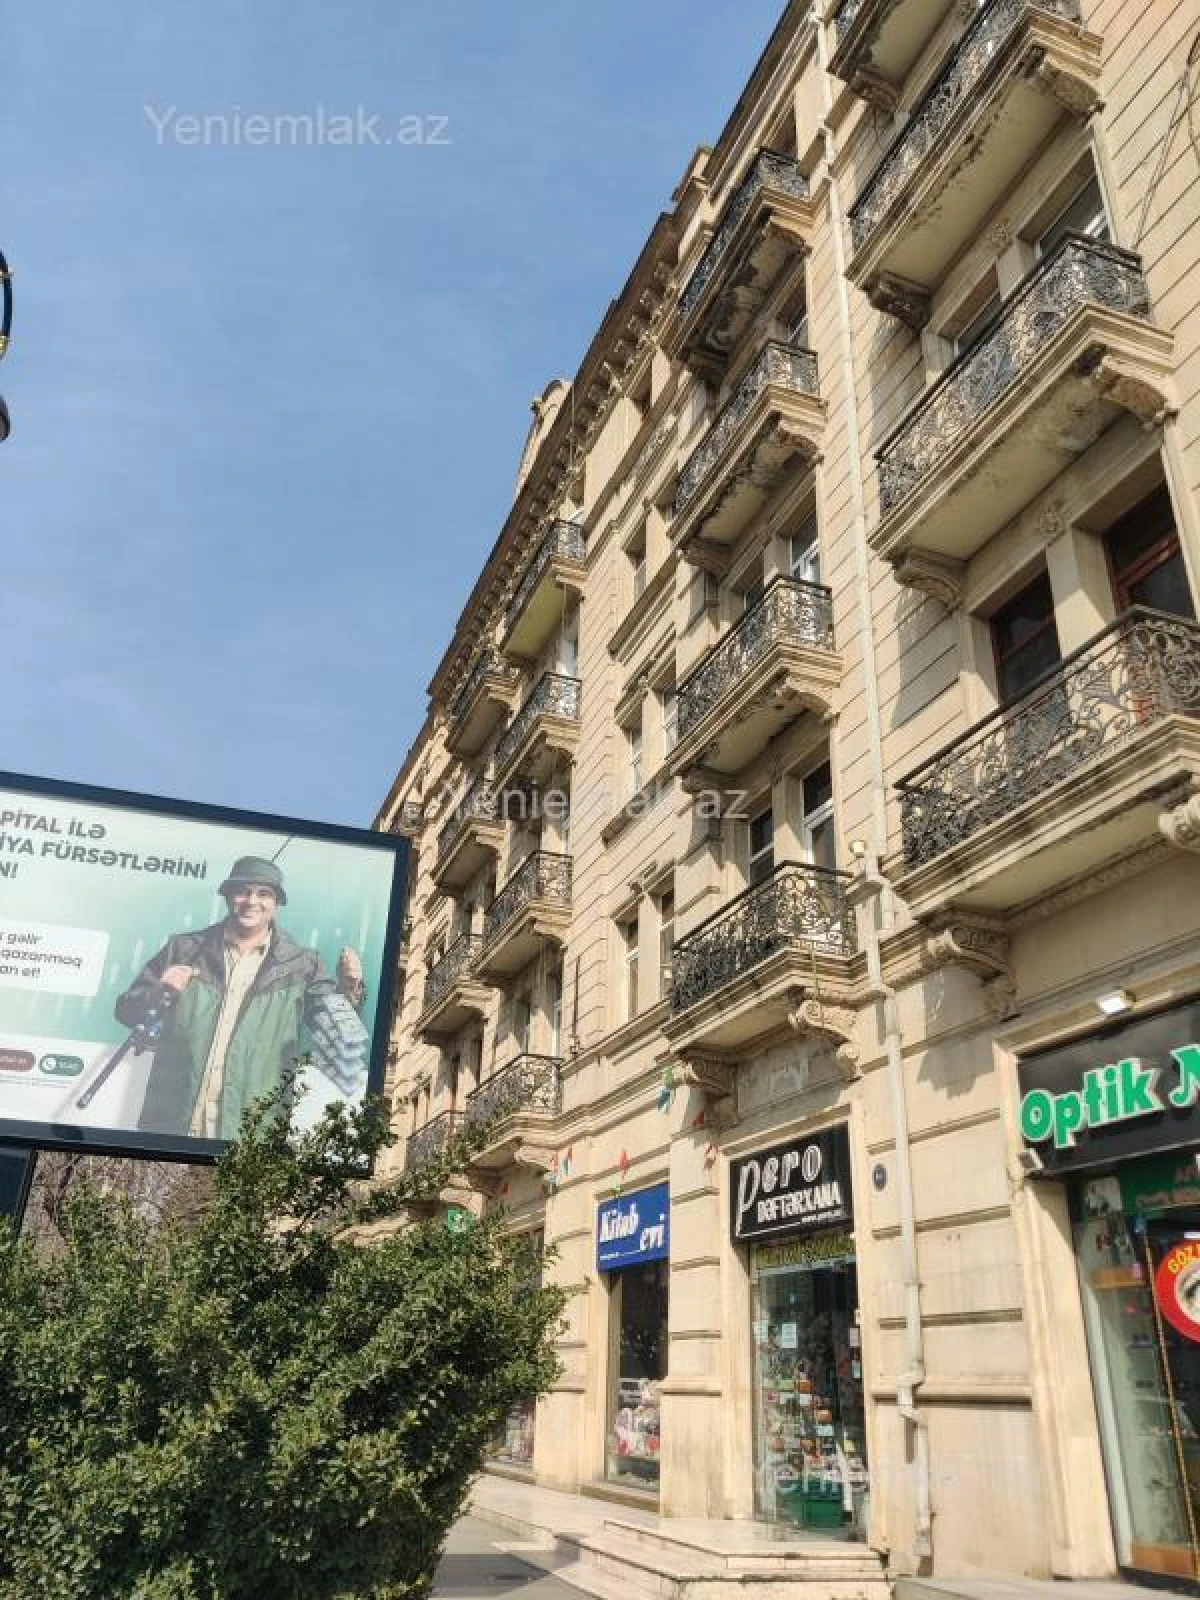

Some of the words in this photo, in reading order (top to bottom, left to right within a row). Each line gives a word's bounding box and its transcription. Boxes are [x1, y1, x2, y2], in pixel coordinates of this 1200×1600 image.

[0, 808, 62, 835] PİTAL
[1020, 1057, 1165, 1149] Optik
[599, 1202, 639, 1243] Kitab
